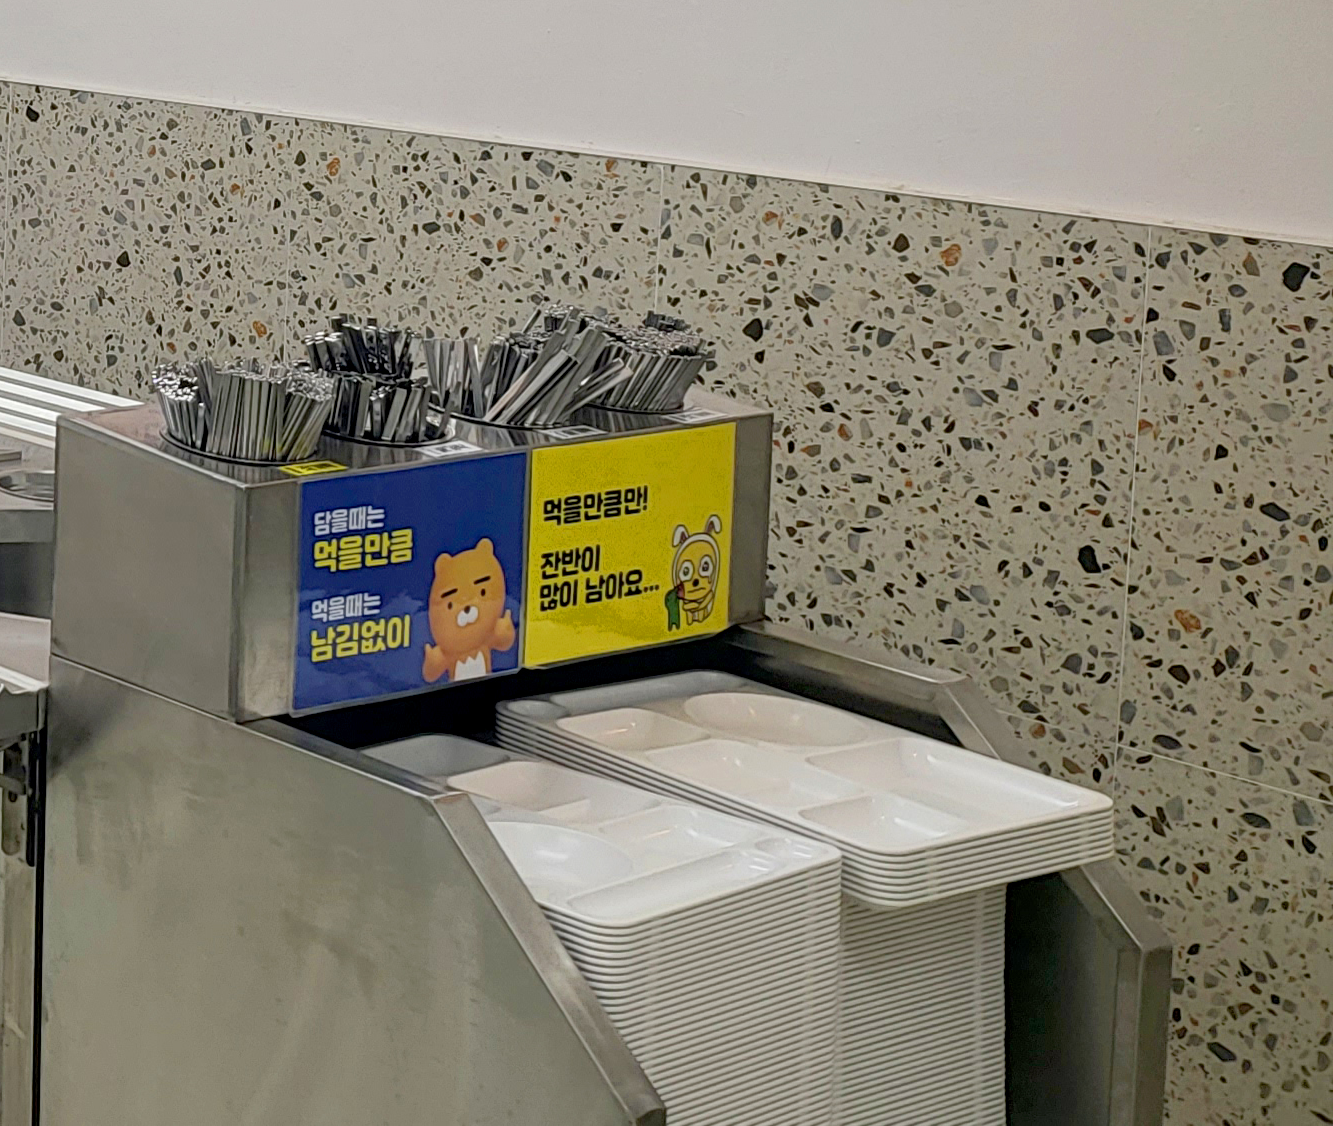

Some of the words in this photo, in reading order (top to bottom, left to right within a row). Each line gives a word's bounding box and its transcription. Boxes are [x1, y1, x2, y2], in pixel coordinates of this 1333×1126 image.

[314, 505, 386, 537] 담을때는
[543, 485, 649, 526] 먹을만큼만!
[313, 528, 413, 572] 먹을만큼
[540, 544, 601, 580] 잔반이
[311, 592, 382, 623] 먹을때는
[539, 579, 579, 612] 많이
[310, 614, 412, 663] 남김없이
